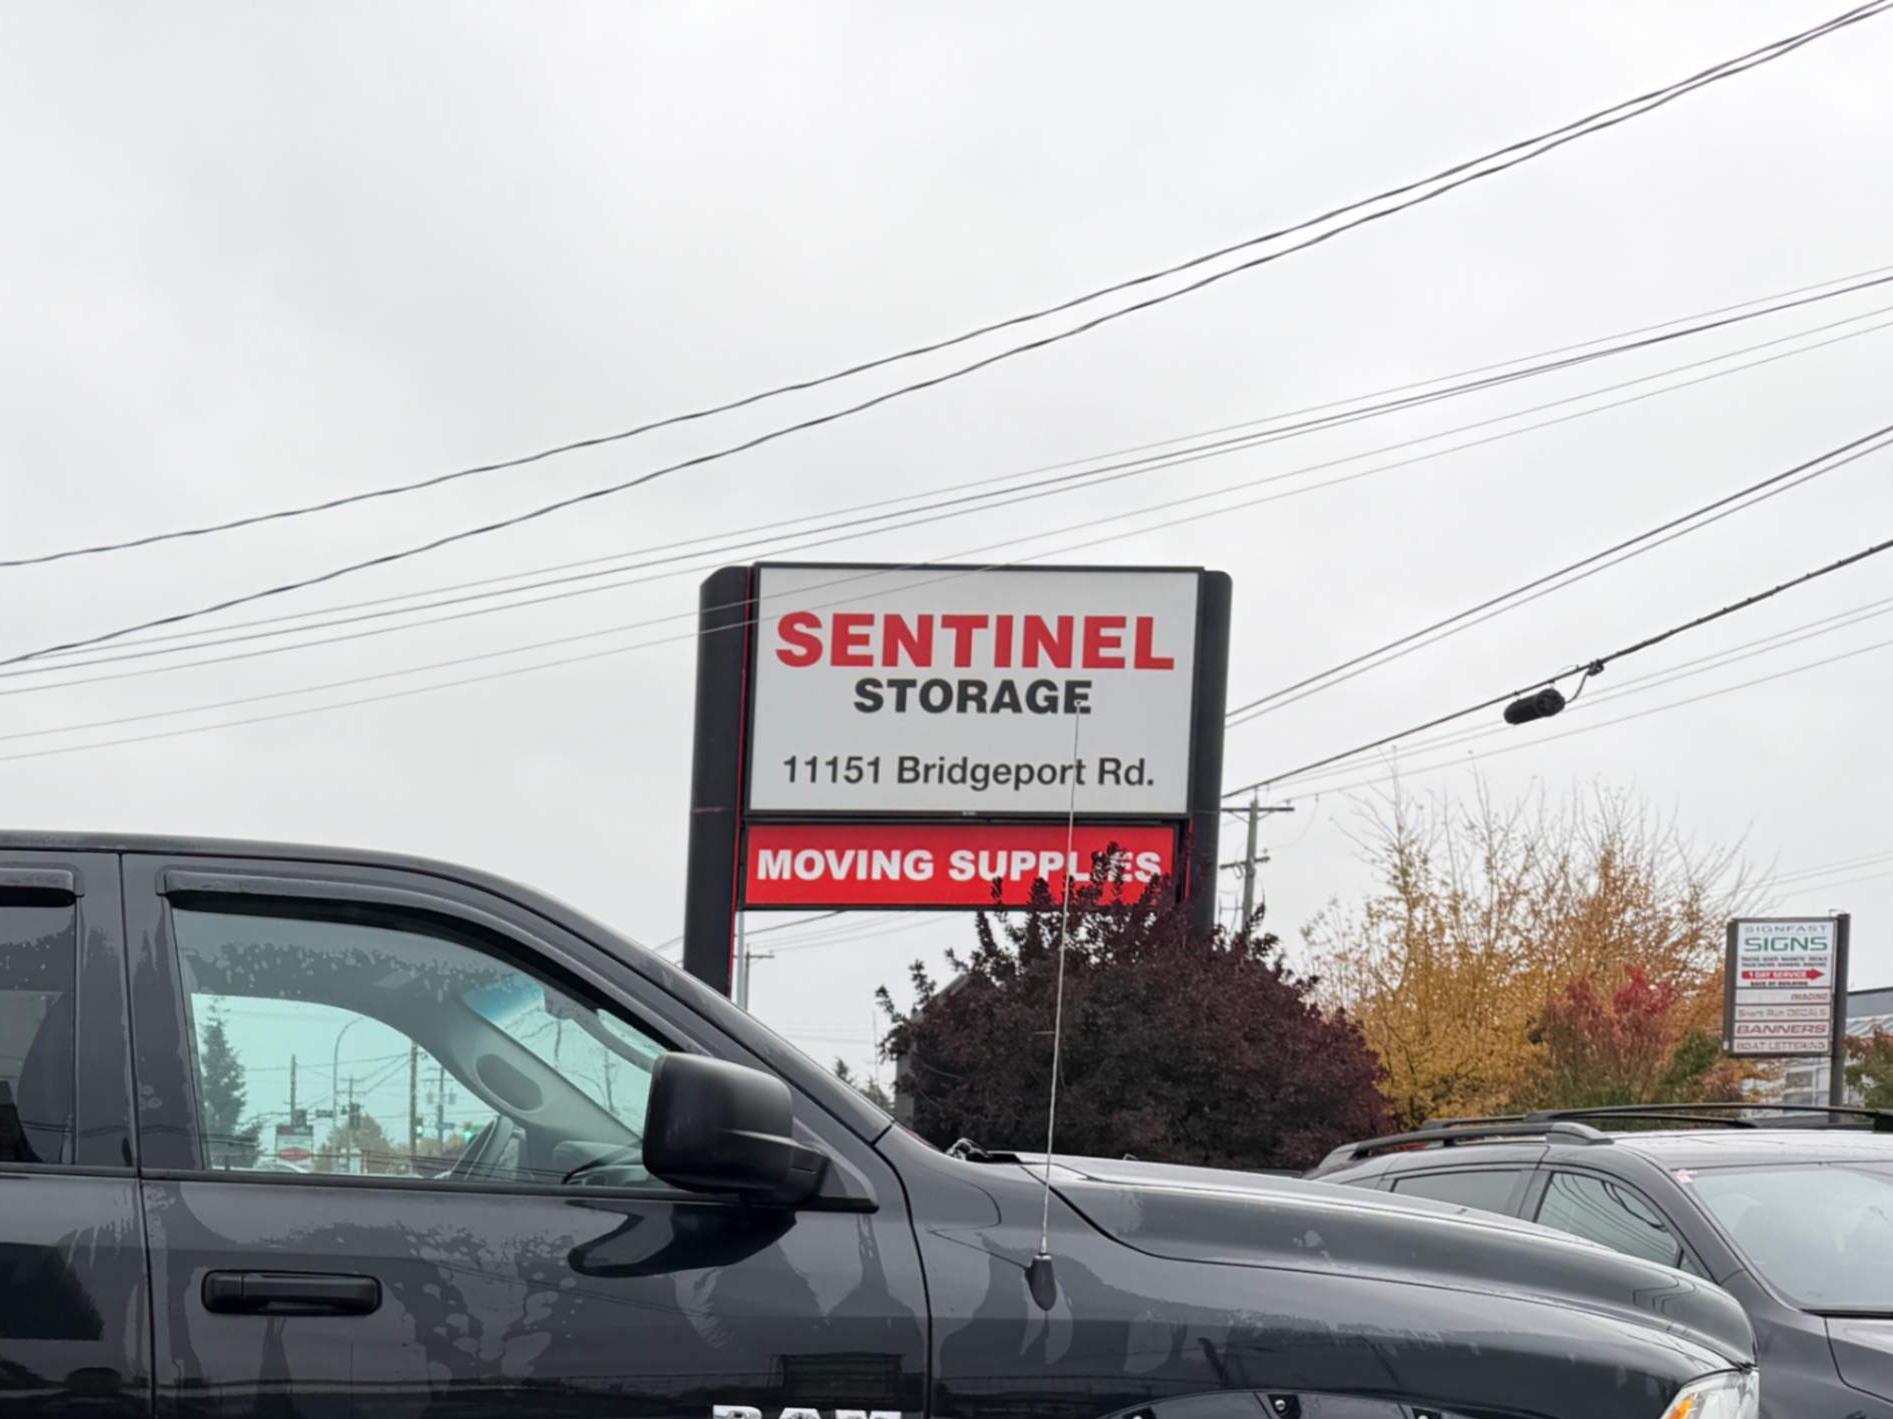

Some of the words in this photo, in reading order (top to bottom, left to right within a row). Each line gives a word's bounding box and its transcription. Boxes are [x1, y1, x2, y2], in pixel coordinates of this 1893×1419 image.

[775, 611, 1175, 670] SENTINEL
[853, 678, 1092, 714] STORAGE
[783, 756, 882, 784] 11151
[896, 755, 1085, 791] Bridgeport
[1098, 757, 1154, 786] Rd.
[756, 849, 934, 881] MOVING
[948, 849, 1162, 882] SUPPLES
[1744, 937, 1828, 952] SIGNS
[1737, 1024, 1827, 1034] BANNERS
